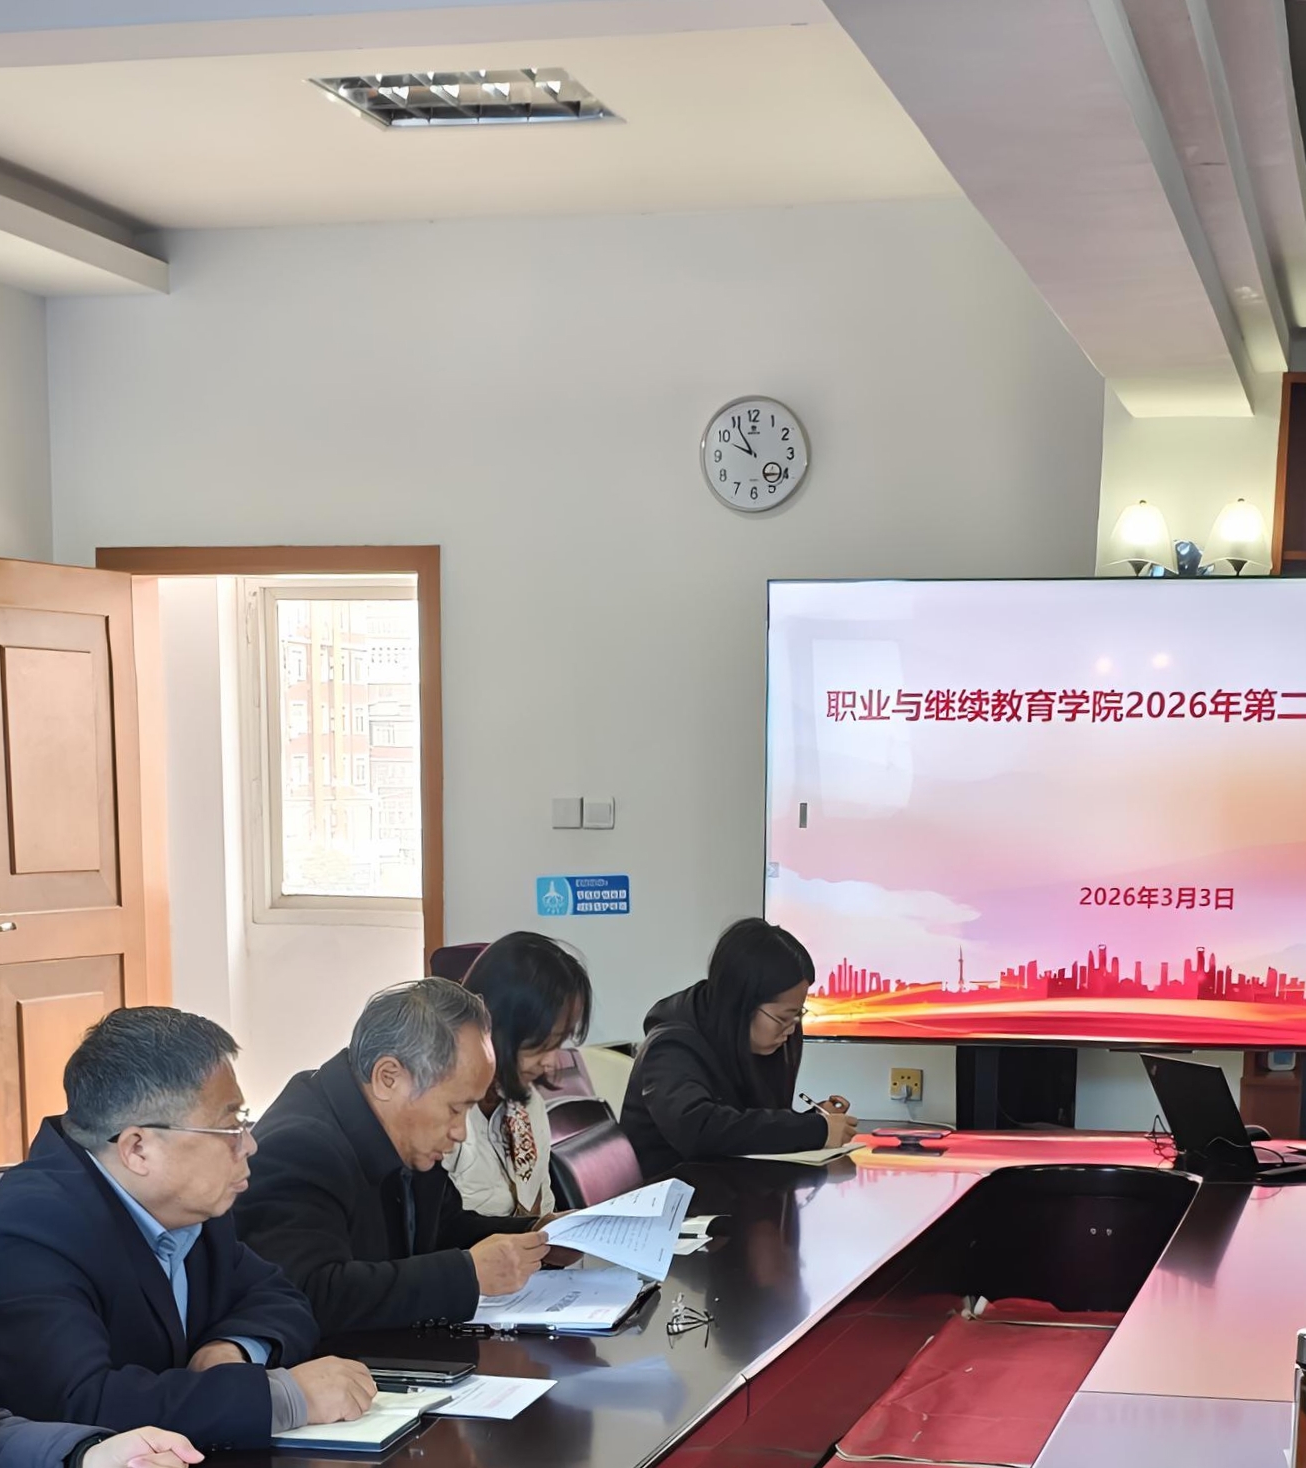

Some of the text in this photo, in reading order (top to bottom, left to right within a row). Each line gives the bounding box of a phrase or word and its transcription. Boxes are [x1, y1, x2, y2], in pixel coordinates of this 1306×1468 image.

[748, 409, 760, 422] 12
[771, 414, 775, 428] 1
[718, 429, 731, 443] 10
[781, 427, 790, 441] 2
[714, 449, 722, 463] 9
[786, 446, 795, 460] 3
[719, 468, 727, 482] 8
[733, 481, 741, 495] 7
[750, 486, 758, 500] 6
[1079, 886, 1235, 910] 2026年3月3日
